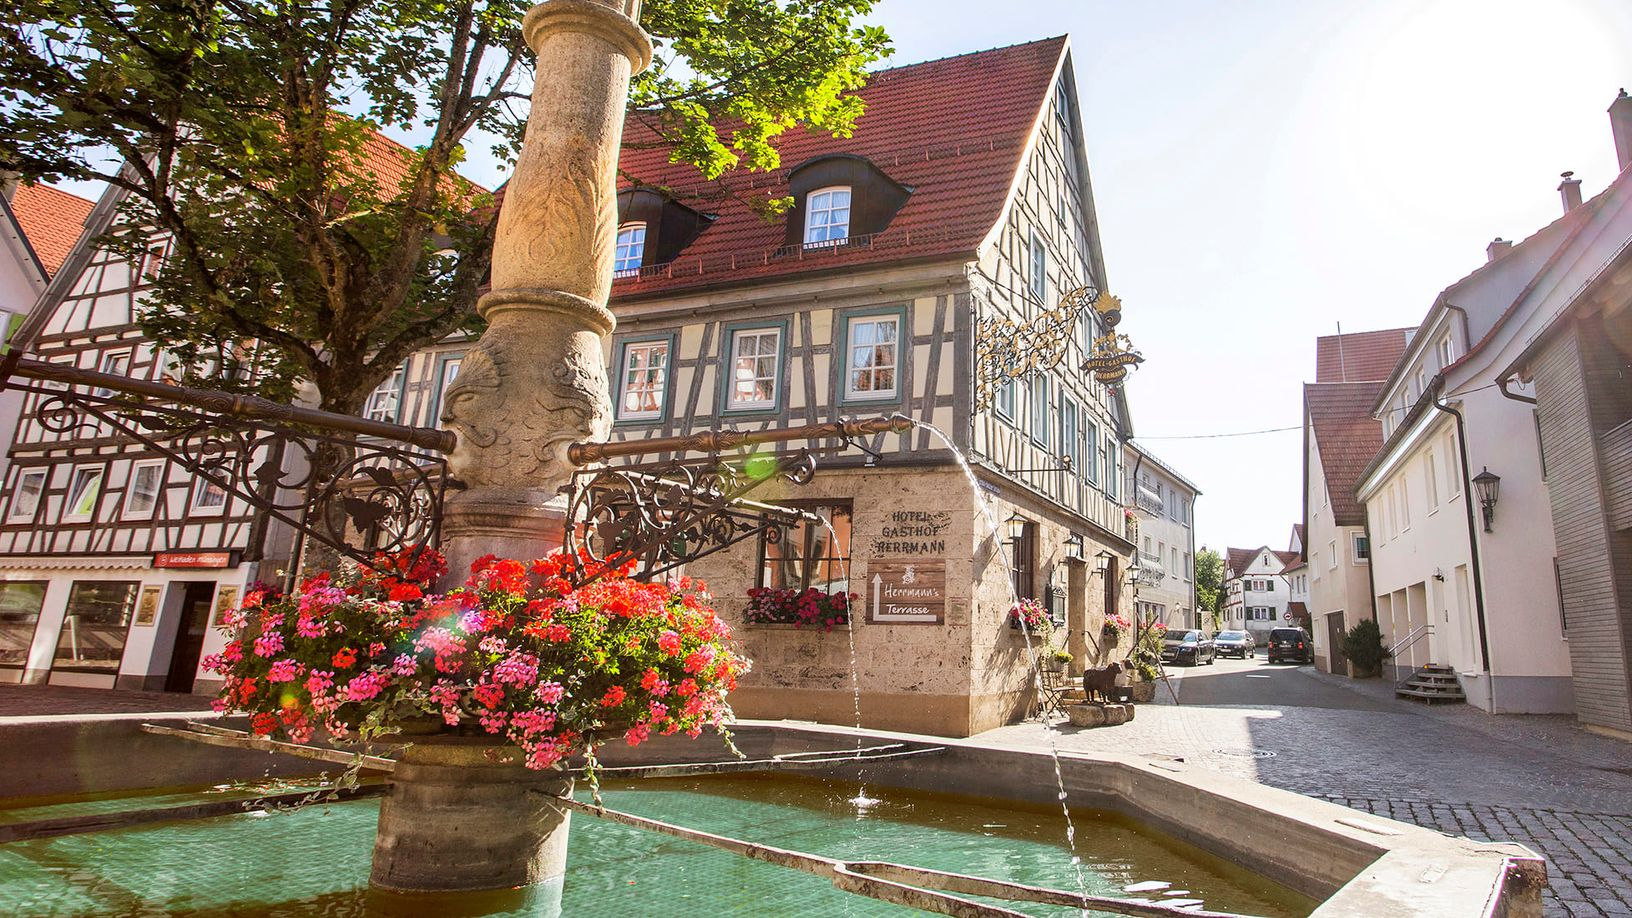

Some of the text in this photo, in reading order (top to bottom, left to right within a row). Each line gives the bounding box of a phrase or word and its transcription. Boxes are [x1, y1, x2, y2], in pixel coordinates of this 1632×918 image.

[892, 511, 930, 521] HOTEL
[882, 526, 939, 538] GASTHOF
[876, 540, 945, 554] HERRMANN
[884, 584, 939, 597] Herrmann's
[886, 604, 929, 614] Terrasse
